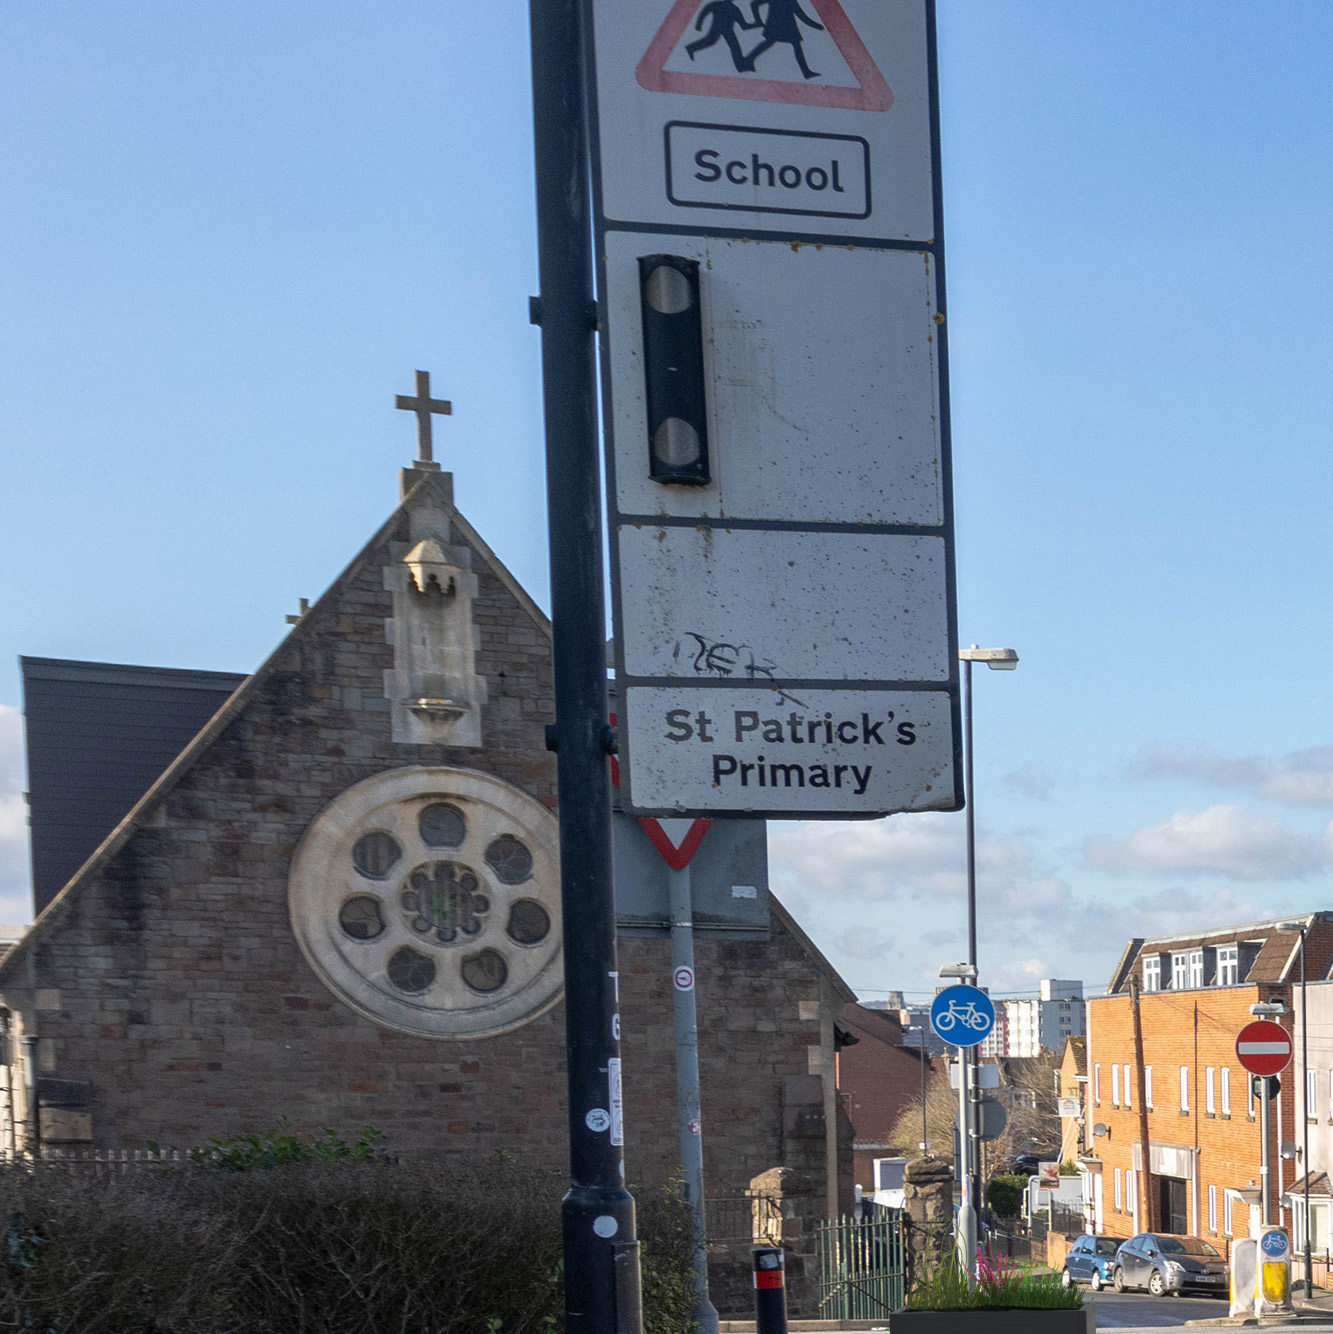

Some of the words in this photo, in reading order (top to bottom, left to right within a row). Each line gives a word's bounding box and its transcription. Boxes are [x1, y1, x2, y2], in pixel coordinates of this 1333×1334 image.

[693, 149, 845, 192] School
[664, 709, 714, 743] St
[734, 710, 917, 746] Patrick's
[712, 754, 873, 795] Primary
